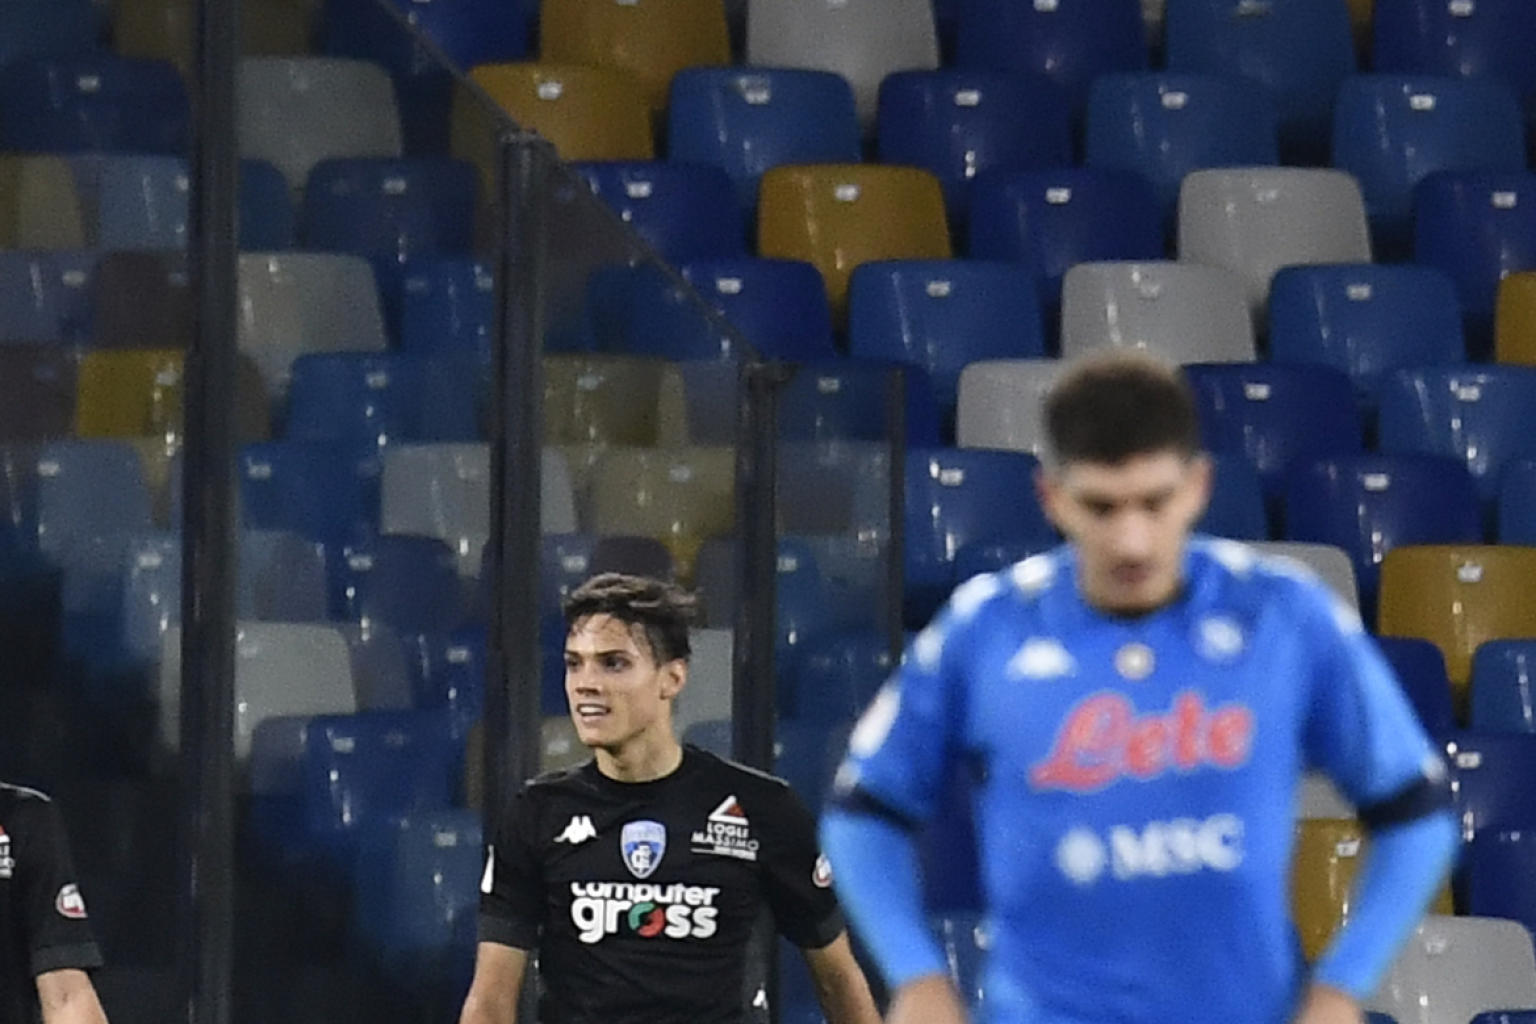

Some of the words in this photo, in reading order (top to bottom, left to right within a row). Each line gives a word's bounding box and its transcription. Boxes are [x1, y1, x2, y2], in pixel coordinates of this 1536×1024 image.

[1028, 690, 1253, 791] Lete
[691, 831, 759, 851] MASSIMO
[707, 822, 749, 838] LOGLI
[1111, 812, 1244, 879] MSC
[571, 881, 719, 905] computer
[571, 896, 718, 944] gross
